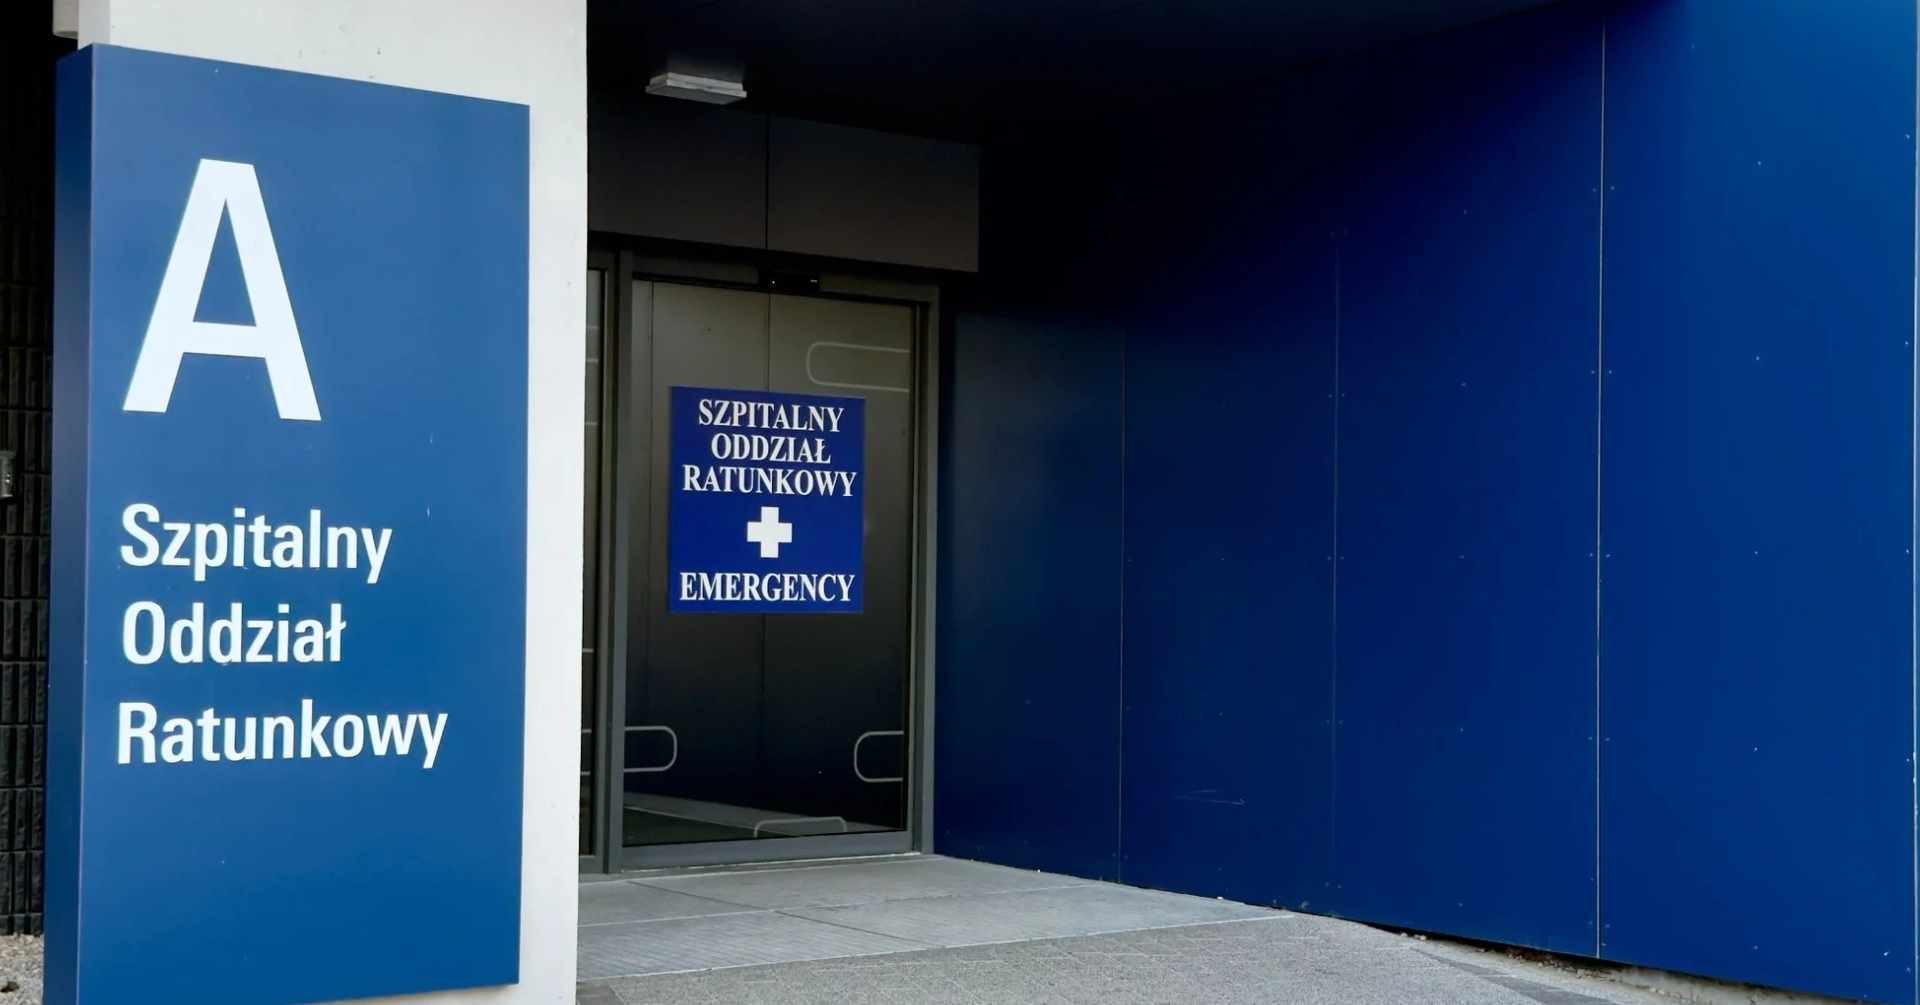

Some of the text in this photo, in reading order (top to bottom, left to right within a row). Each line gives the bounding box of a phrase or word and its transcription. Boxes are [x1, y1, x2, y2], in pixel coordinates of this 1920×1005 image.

[123, 158, 321, 421] A
[698, 398, 844, 432] SZPITALNY
[711, 433, 831, 463] ODDZIAŁ
[682, 464, 857, 496] RATUNKOWY
[120, 502, 393, 584] Szpitalny
[679, 572, 855, 601] EMERGENCY
[122, 600, 347, 664] Oddział
[117, 698, 449, 769] Ratunkowy
